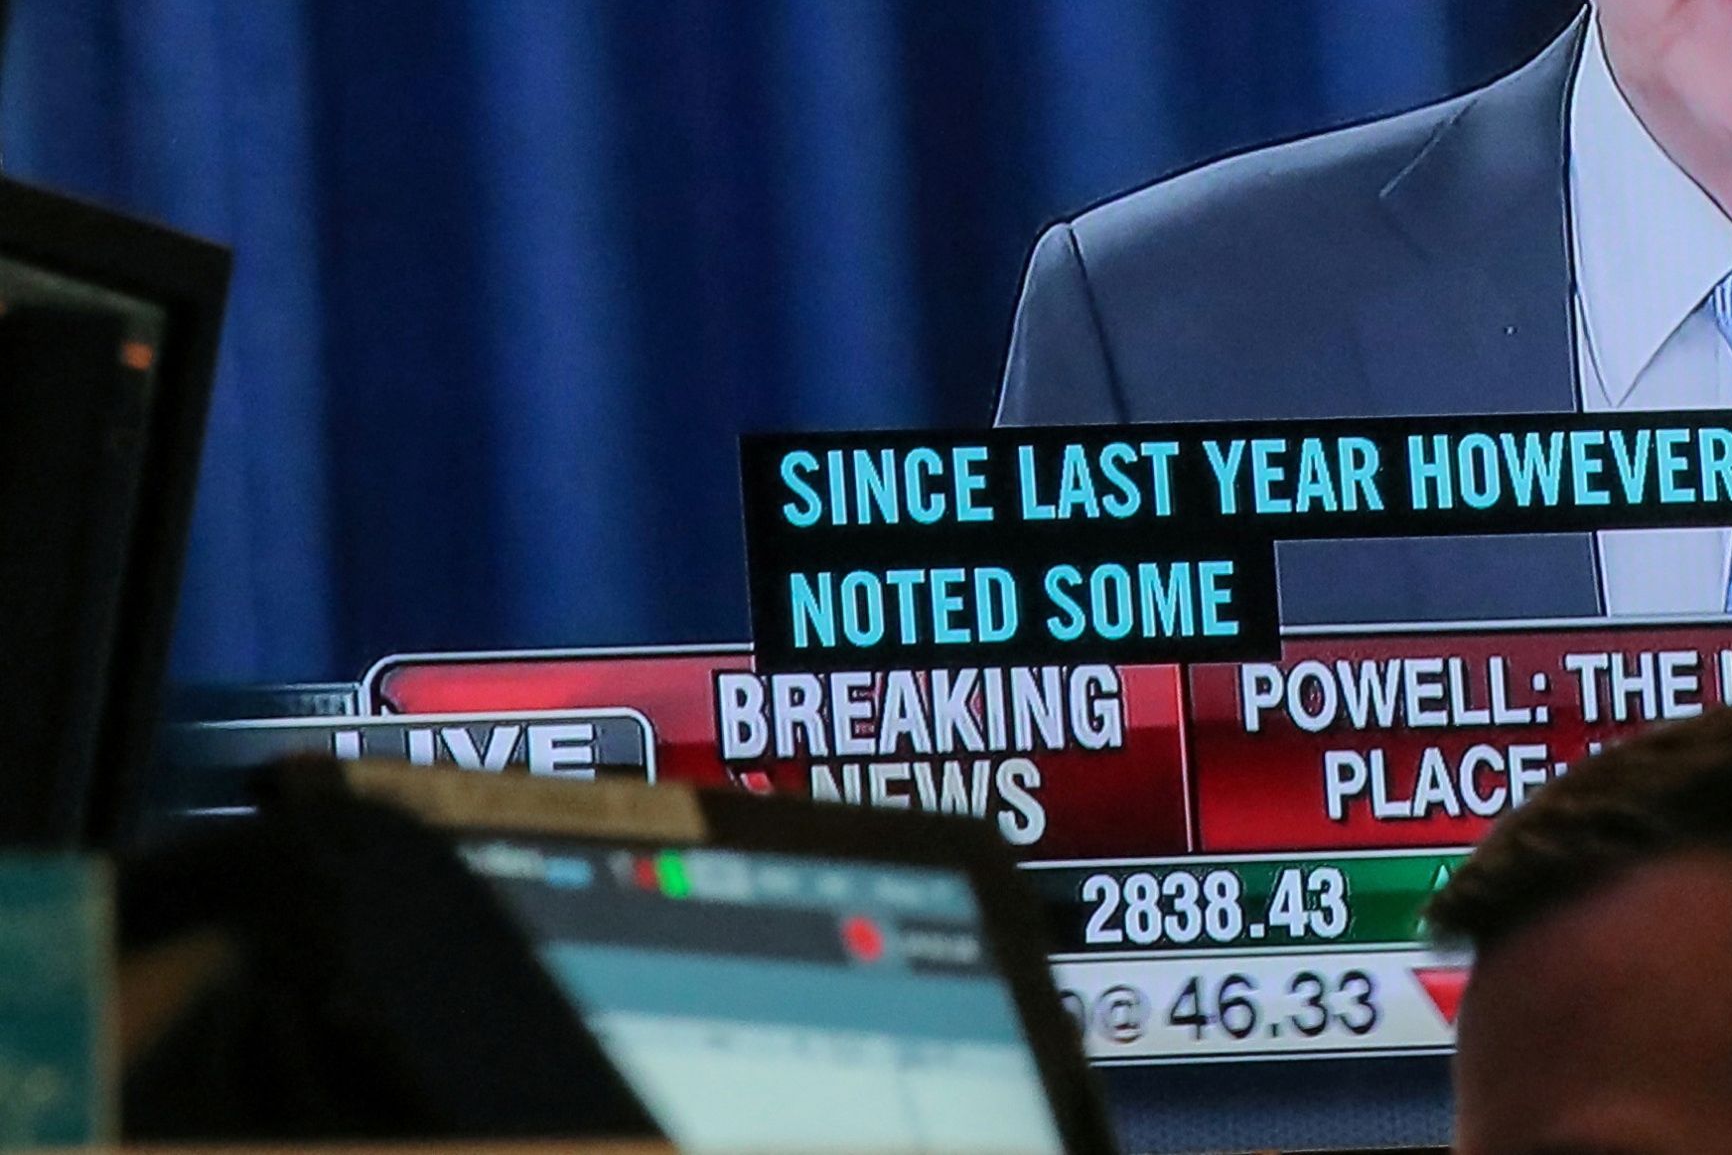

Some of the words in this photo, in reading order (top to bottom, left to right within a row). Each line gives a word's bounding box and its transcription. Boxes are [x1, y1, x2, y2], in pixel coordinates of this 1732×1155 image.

[780, 446, 994, 527] SINCE
[1018, 441, 1179, 520] LAST
[1202, 436, 1384, 514] YEAR
[790, 567, 1018, 648] NOTED
[1045, 560, 1239, 640] SOME
[717, 664, 1124, 760] BREAKING
[1241, 656, 1550, 732] POWELL:
[1565, 650, 1704, 723] THE
[1082, 866, 1349, 945] 2838.43
[1166, 969, 1378, 1040] 46.33
